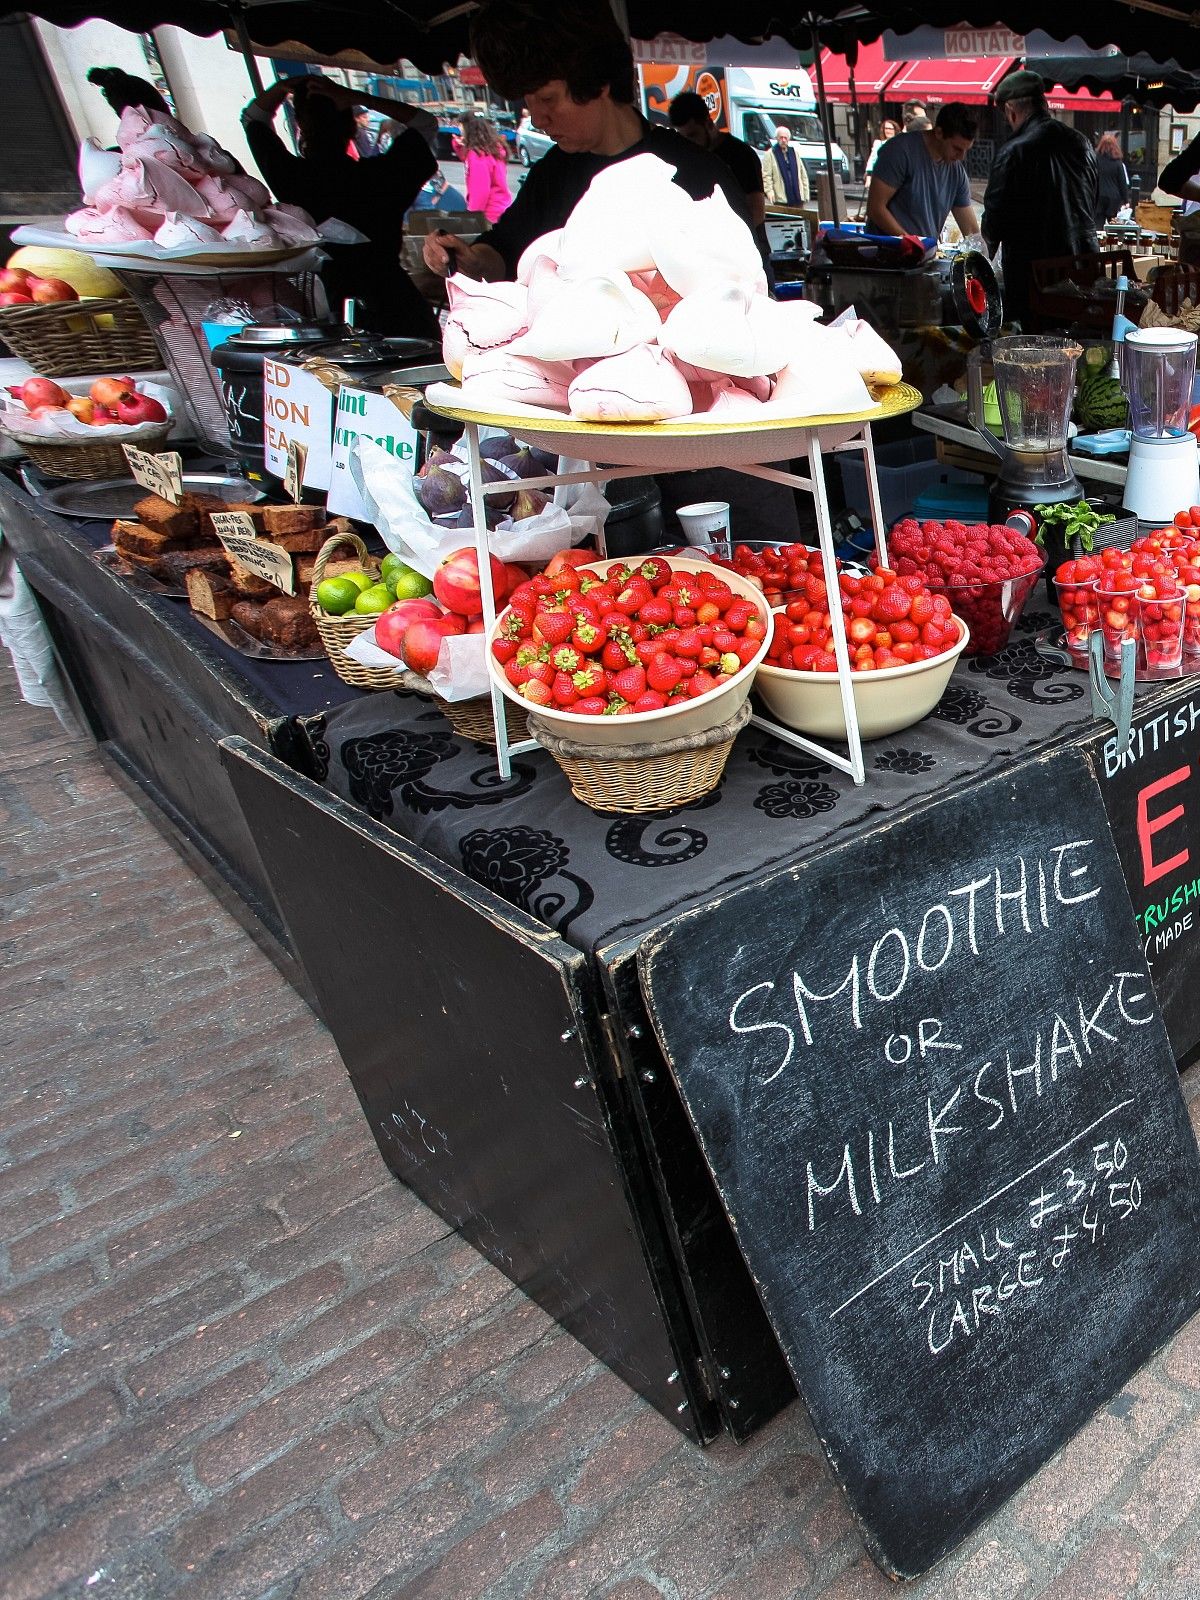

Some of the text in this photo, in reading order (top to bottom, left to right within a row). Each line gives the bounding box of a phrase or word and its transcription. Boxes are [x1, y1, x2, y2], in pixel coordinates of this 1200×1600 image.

[728, 839, 1102, 1085] SMOOTHIE
[884, 1018, 963, 1064] OR
[806, 971, 1154, 1231] MILKSHAKE
[911, 1228, 1013, 1310] SMALL
[928, 1251, 1043, 1354] LARGE
